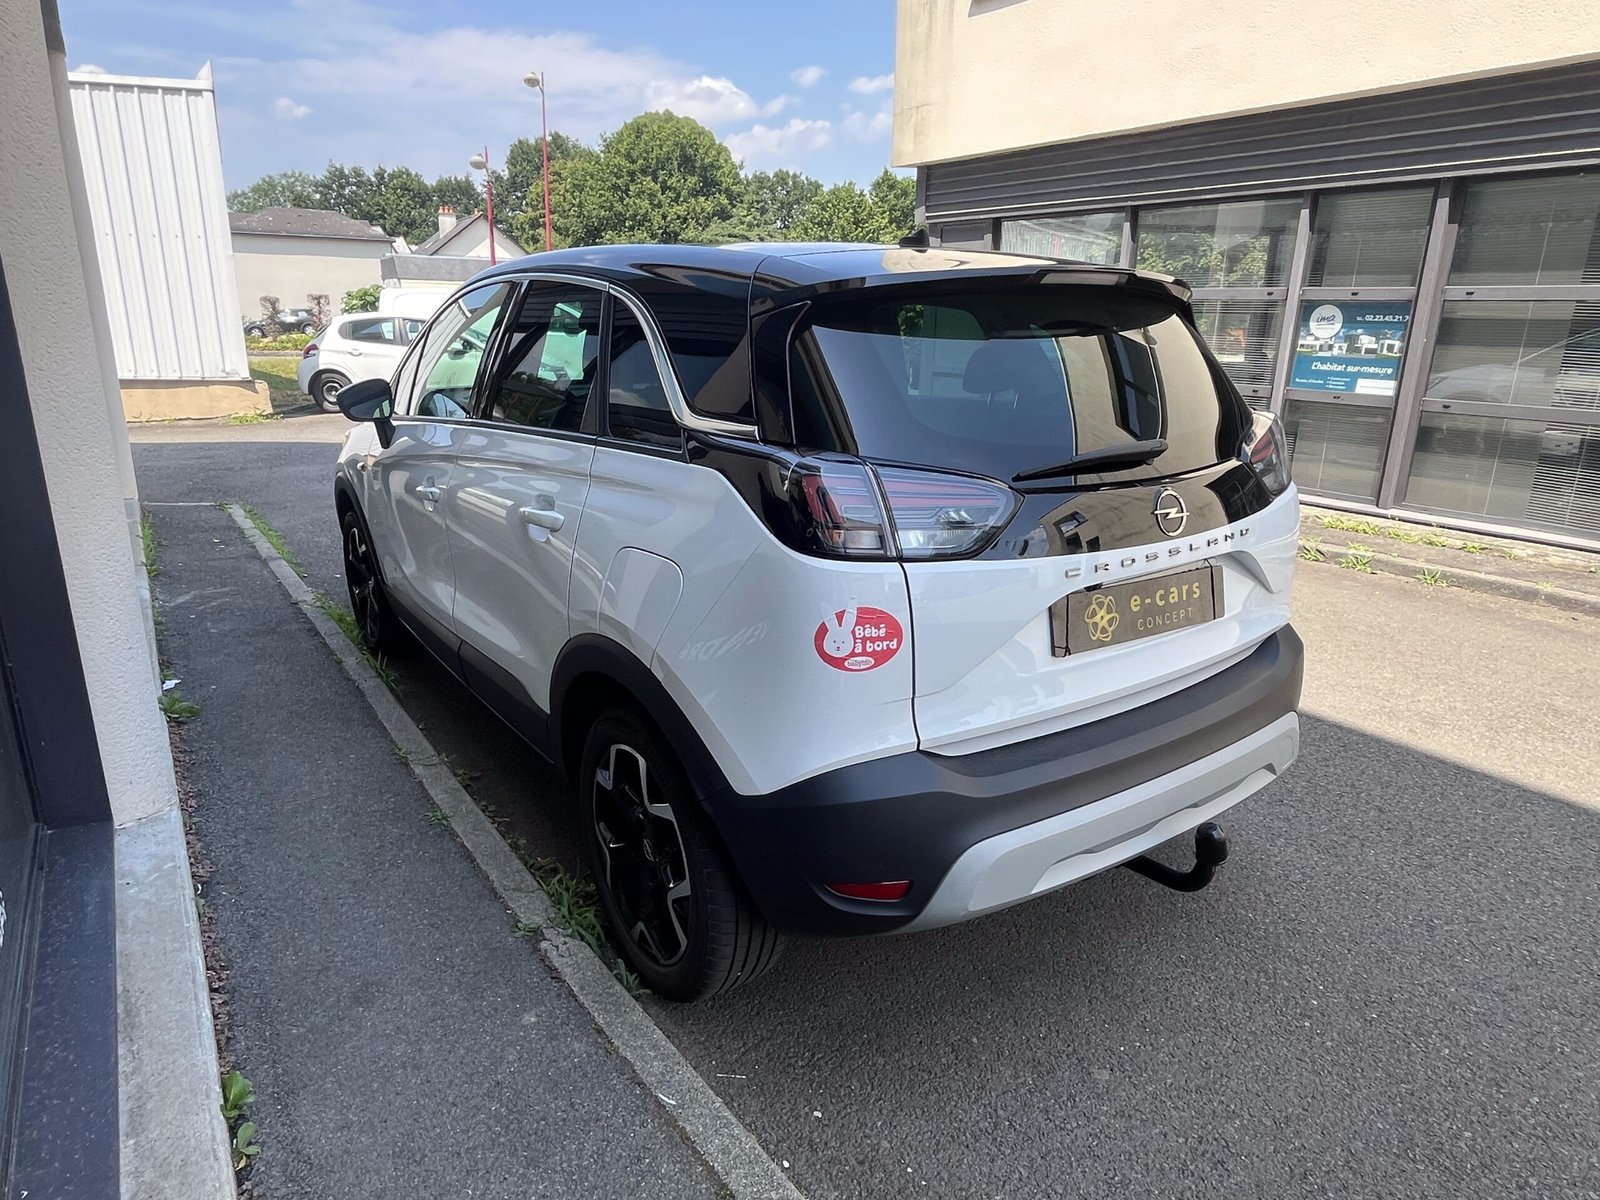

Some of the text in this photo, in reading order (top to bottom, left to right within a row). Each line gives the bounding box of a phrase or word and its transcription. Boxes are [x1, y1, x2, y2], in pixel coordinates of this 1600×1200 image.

[1311, 361, 1393, 375] L'habitat sur-mesure
[1065, 527, 1249, 579] CROSSLAND
[1130, 581, 1201, 613] e-cars
[1137, 607, 1193, 631] CONCEPT
[855, 624, 886, 638] Bébé
[854, 638, 897, 653] à bord
